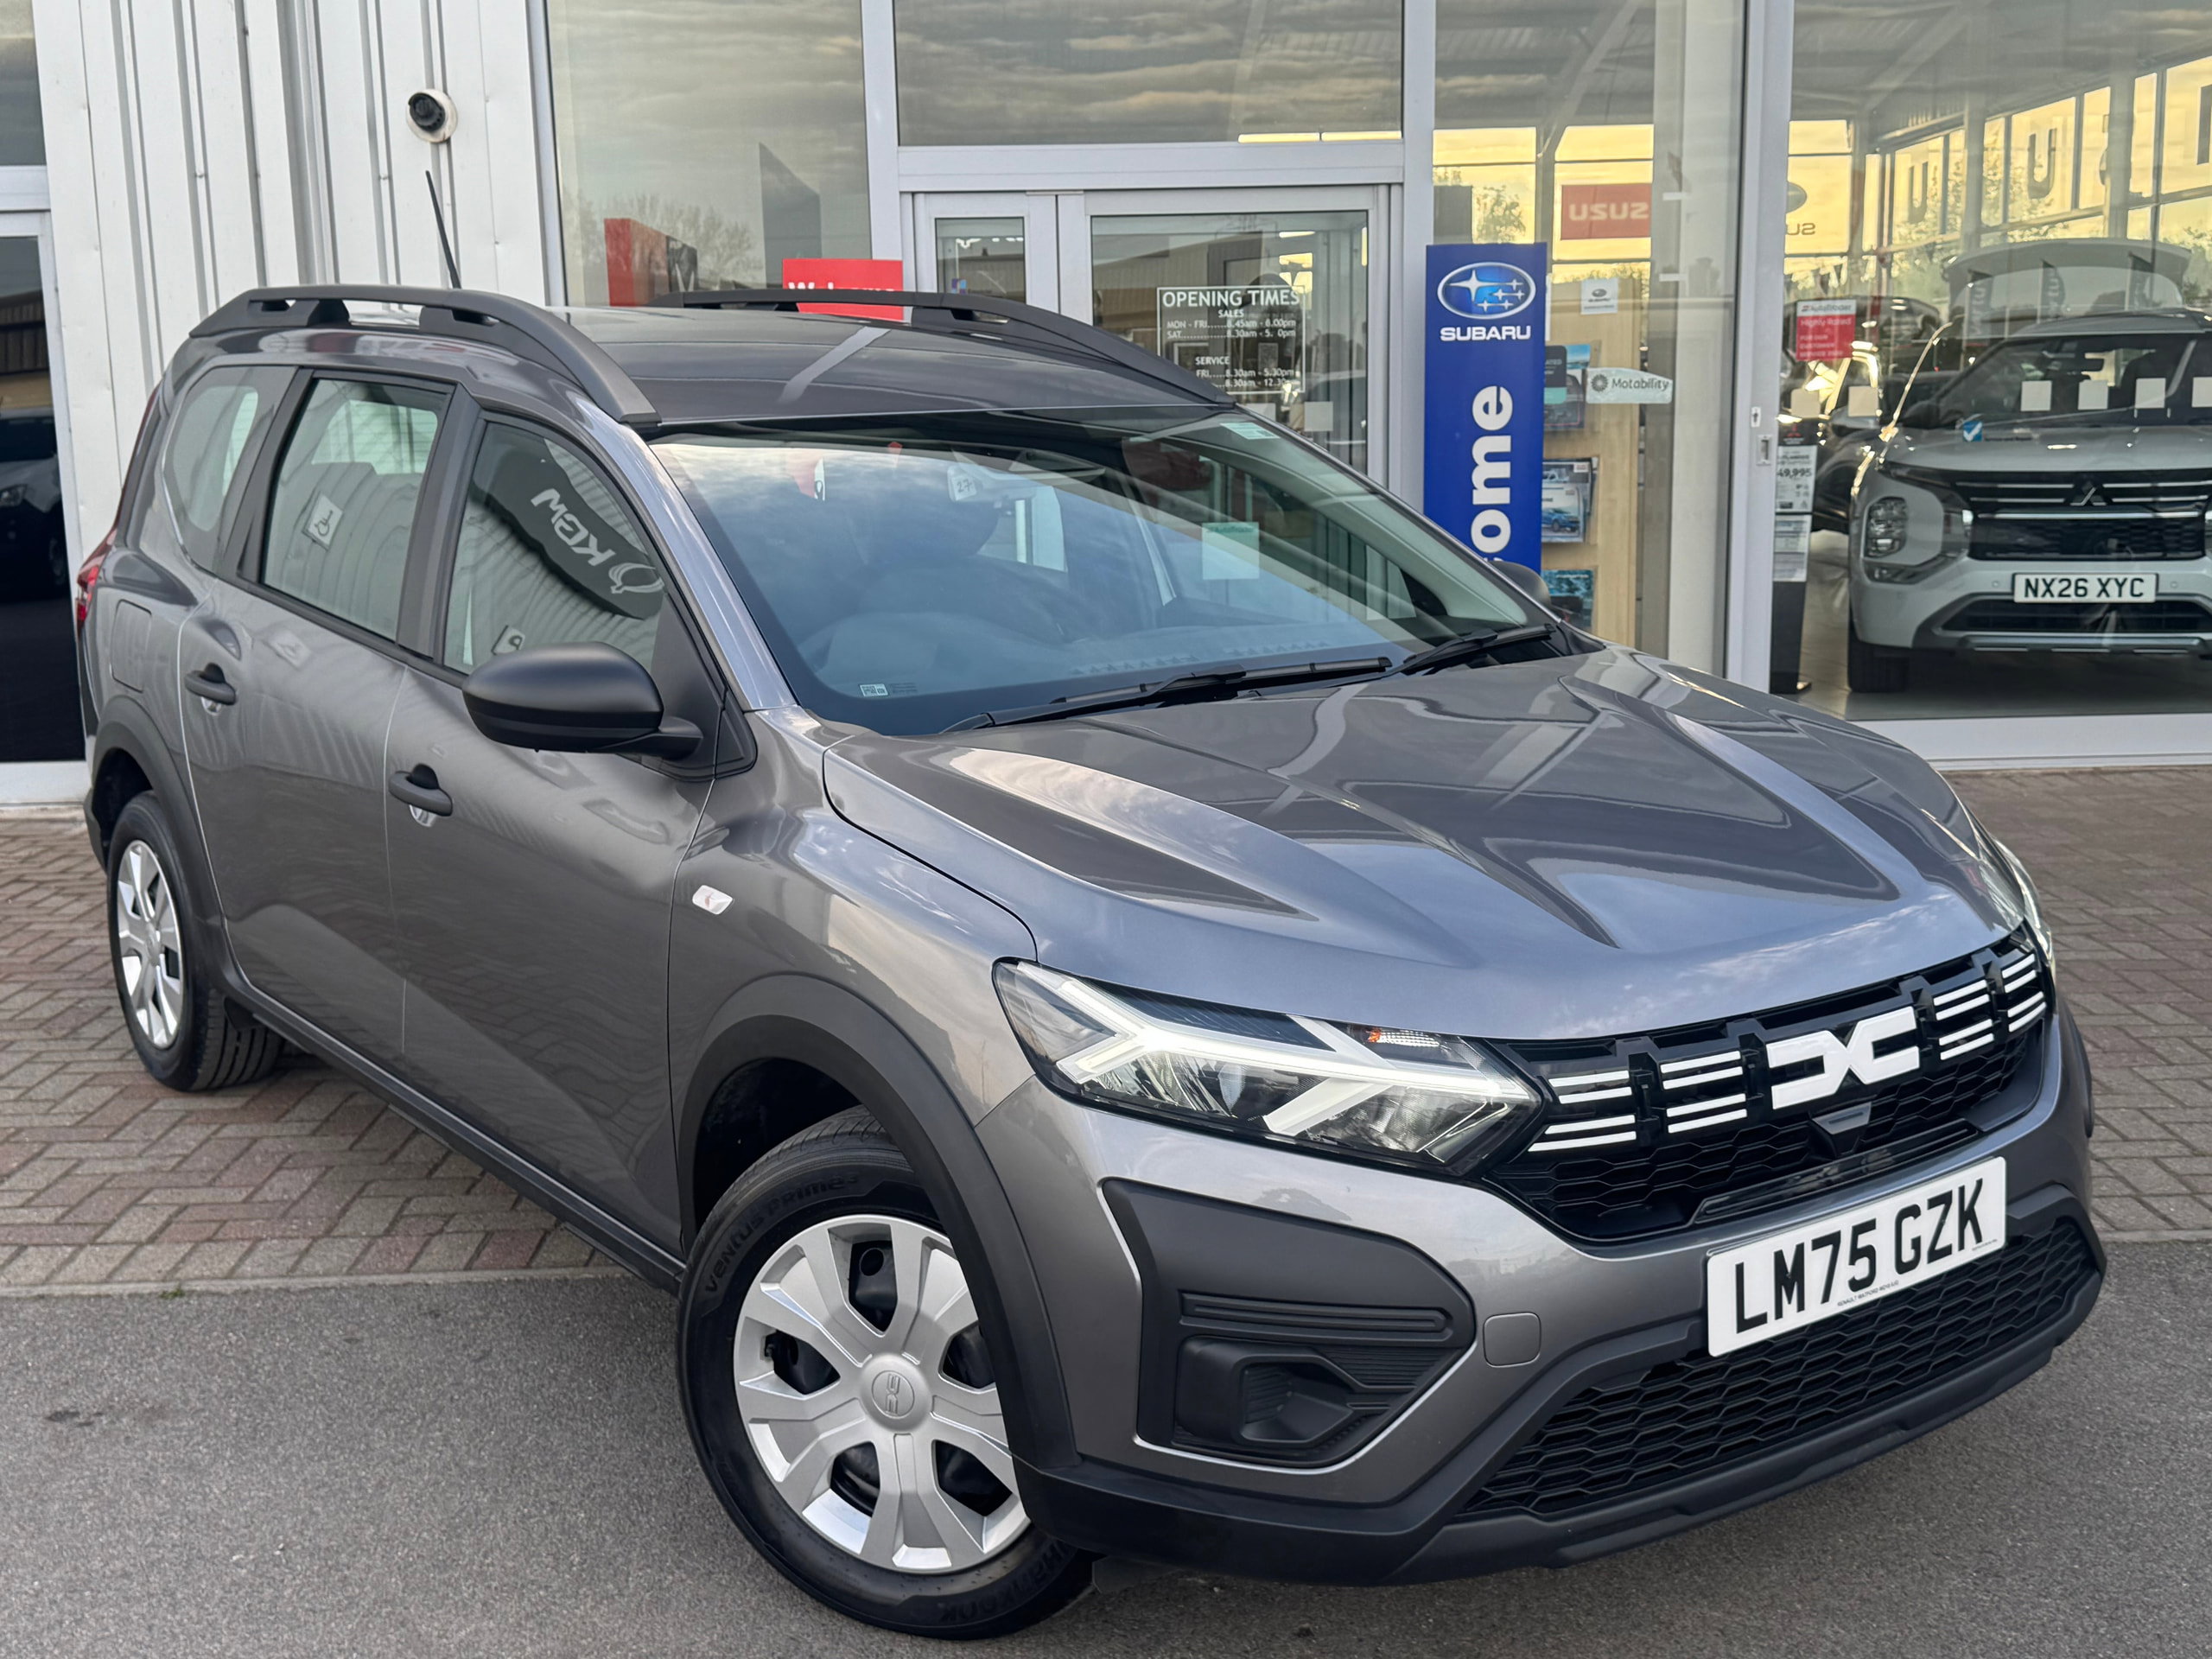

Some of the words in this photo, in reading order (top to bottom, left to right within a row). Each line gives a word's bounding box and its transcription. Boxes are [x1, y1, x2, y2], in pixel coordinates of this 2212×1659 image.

[1162, 290, 1243, 308] OPENING
[1247, 289, 1300, 306] TIMES
[1217, 308, 1245, 318] SALES
[1166, 320, 1186, 328] MON
[1440, 326, 1531, 341] SUBARU
[1195, 355, 1230, 365] SERVICE
[1611, 378, 1670, 391] Motability
[1471, 385, 1513, 560] ome
[2024, 577, 2089, 598] NX26
[2096, 577, 2145, 598] XYC
[1734, 1217, 1877, 1335] LM75
[1894, 1177, 1984, 1275] GZK
